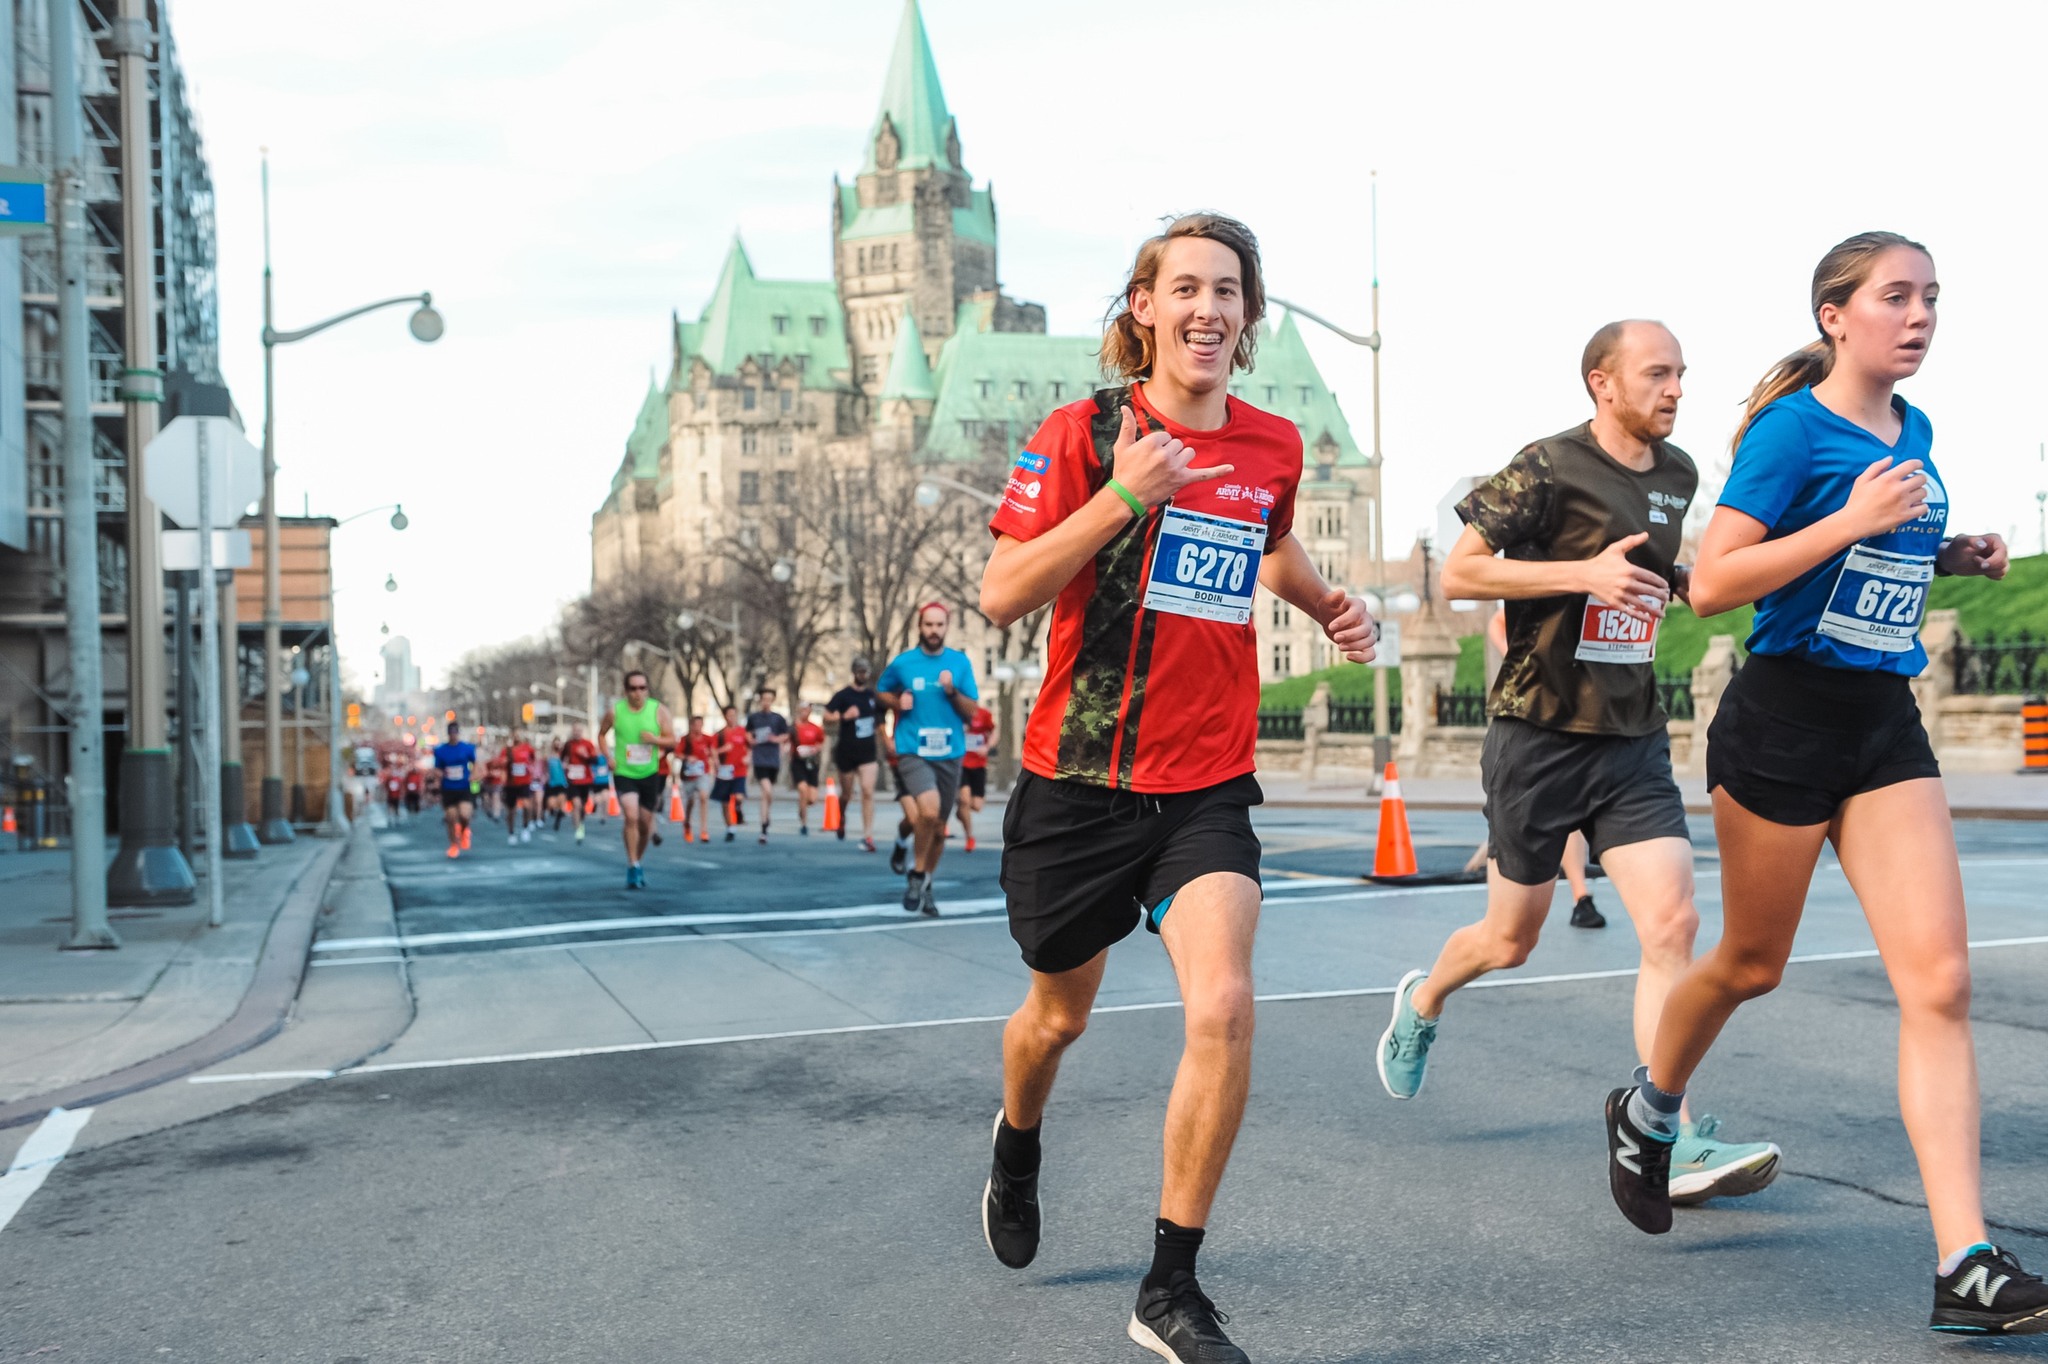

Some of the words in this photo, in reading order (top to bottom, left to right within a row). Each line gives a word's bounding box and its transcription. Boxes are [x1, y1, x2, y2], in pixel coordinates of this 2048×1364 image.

[1215, 487, 1240, 497] ARMY
[1176, 543, 1248, 592] 6278
[1194, 591, 1223, 603] BODIN
[1855, 579, 1923, 623] 6723
[1597, 609, 1648, 641] 15201
[1868, 624, 1901, 635] DANIKA
